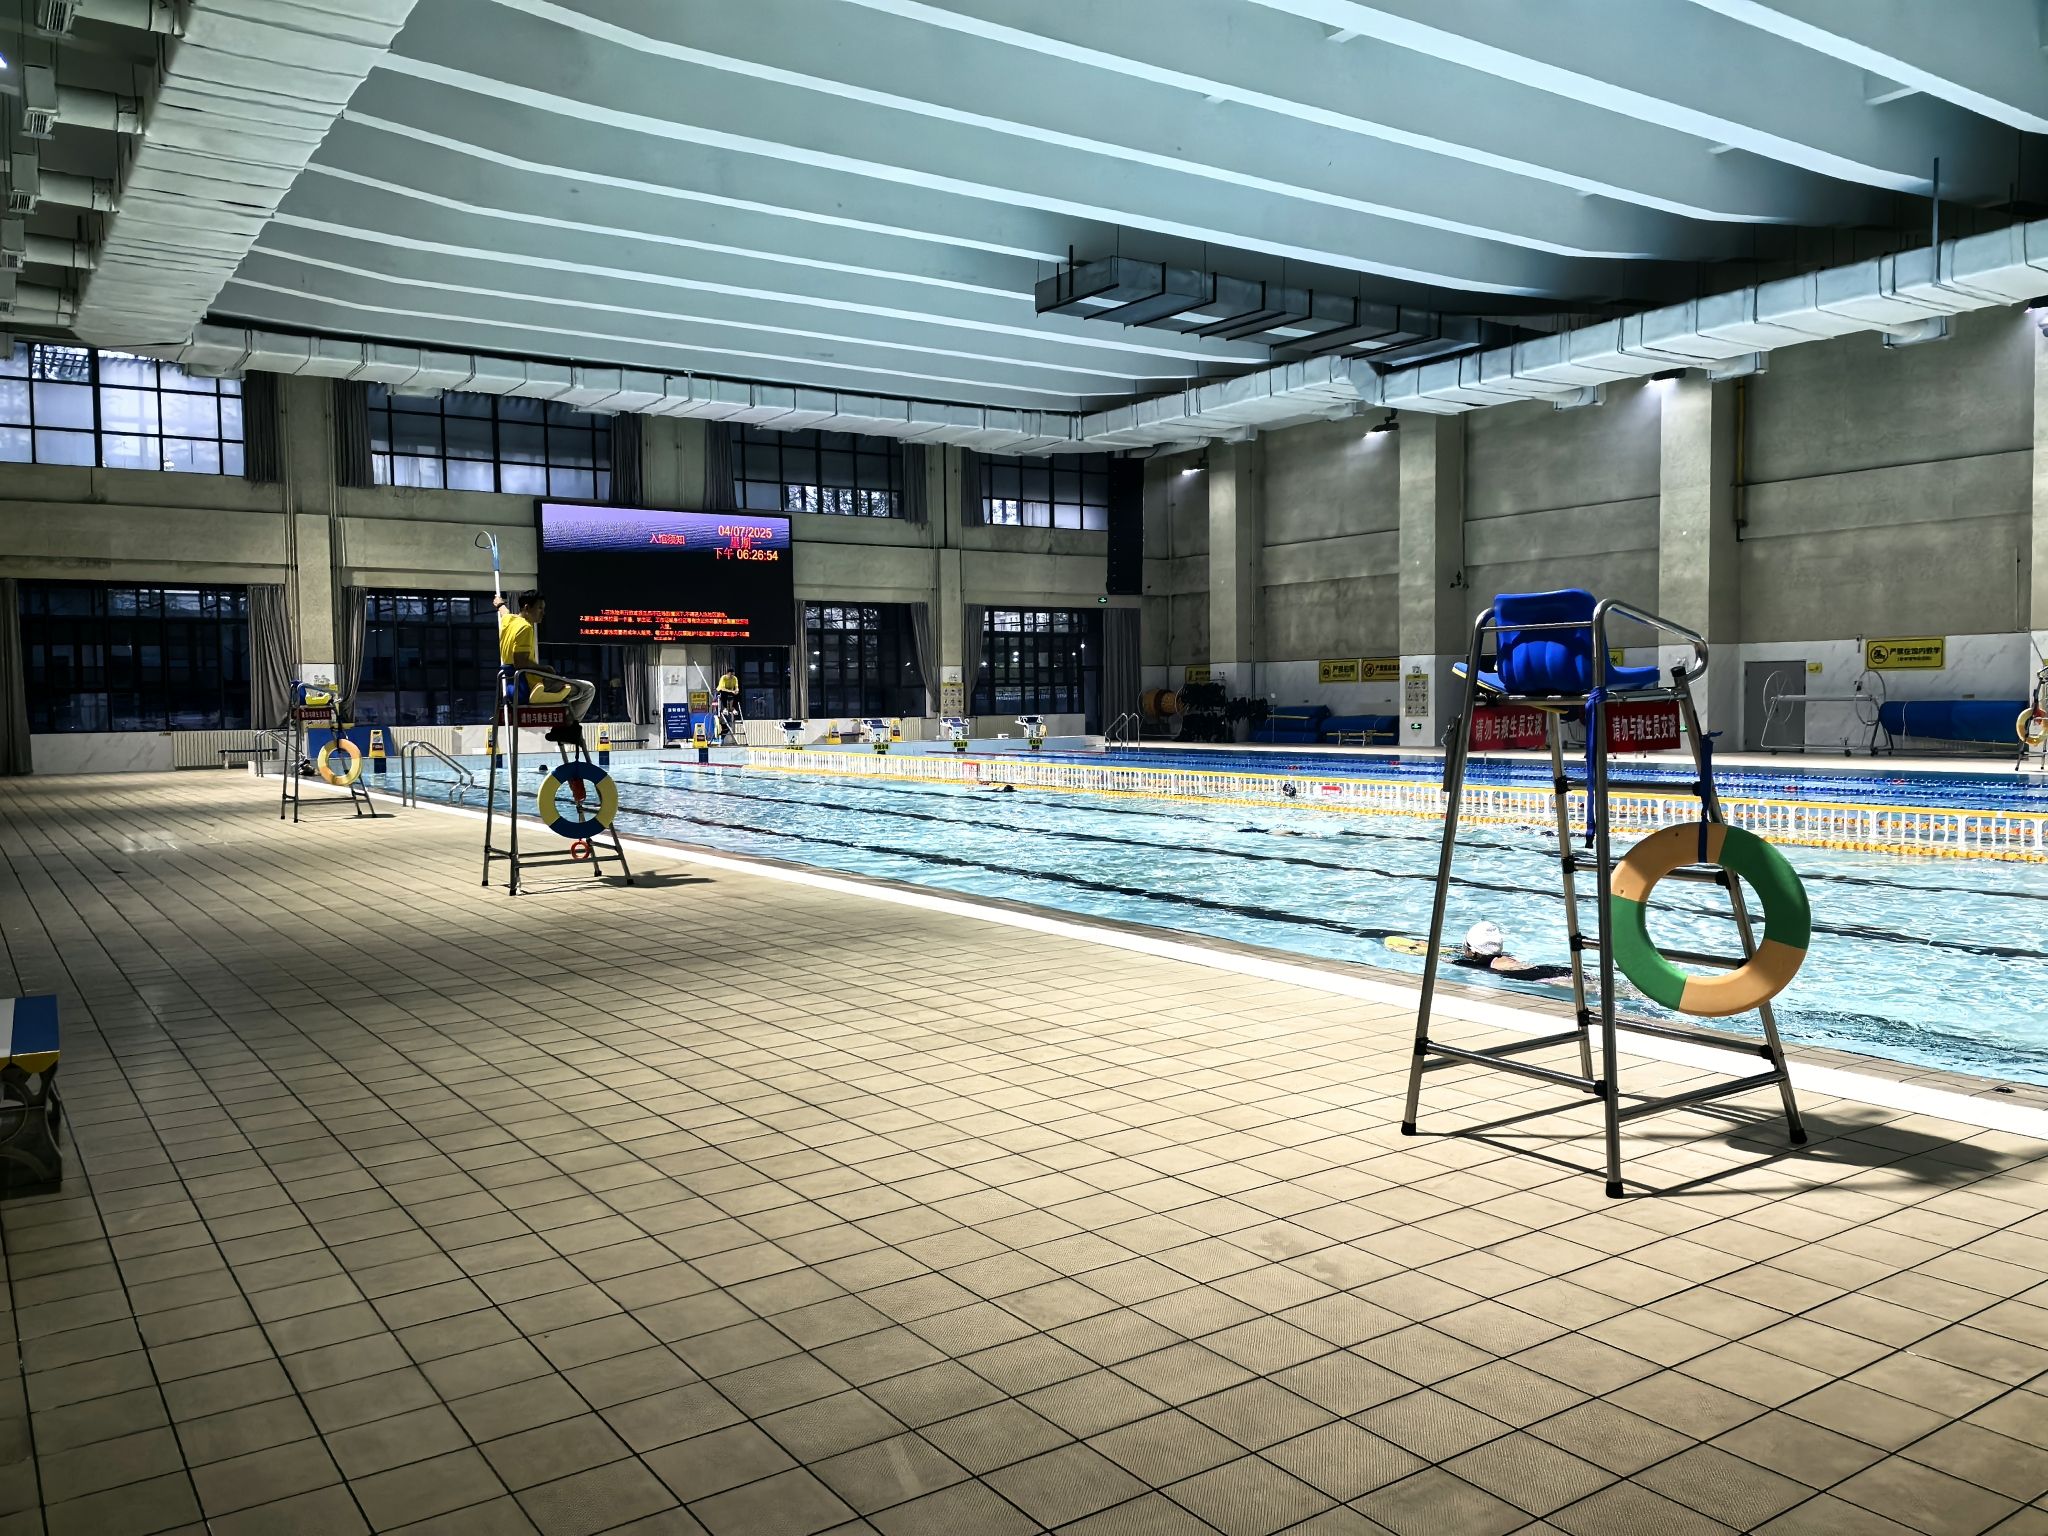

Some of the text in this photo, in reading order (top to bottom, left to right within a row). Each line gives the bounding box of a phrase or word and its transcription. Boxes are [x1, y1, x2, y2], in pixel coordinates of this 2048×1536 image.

[718, 525, 772, 538] 04/07/2025
[649, 533, 685, 545] 入馆须知
[730, 536, 761, 549] 星期一
[713, 547, 778, 561] 下午 06:26:54
[1475, 713, 1543, 740] 请勿与救生员交谈
[1612, 714, 1677, 742] 请勿与救生员交谈
